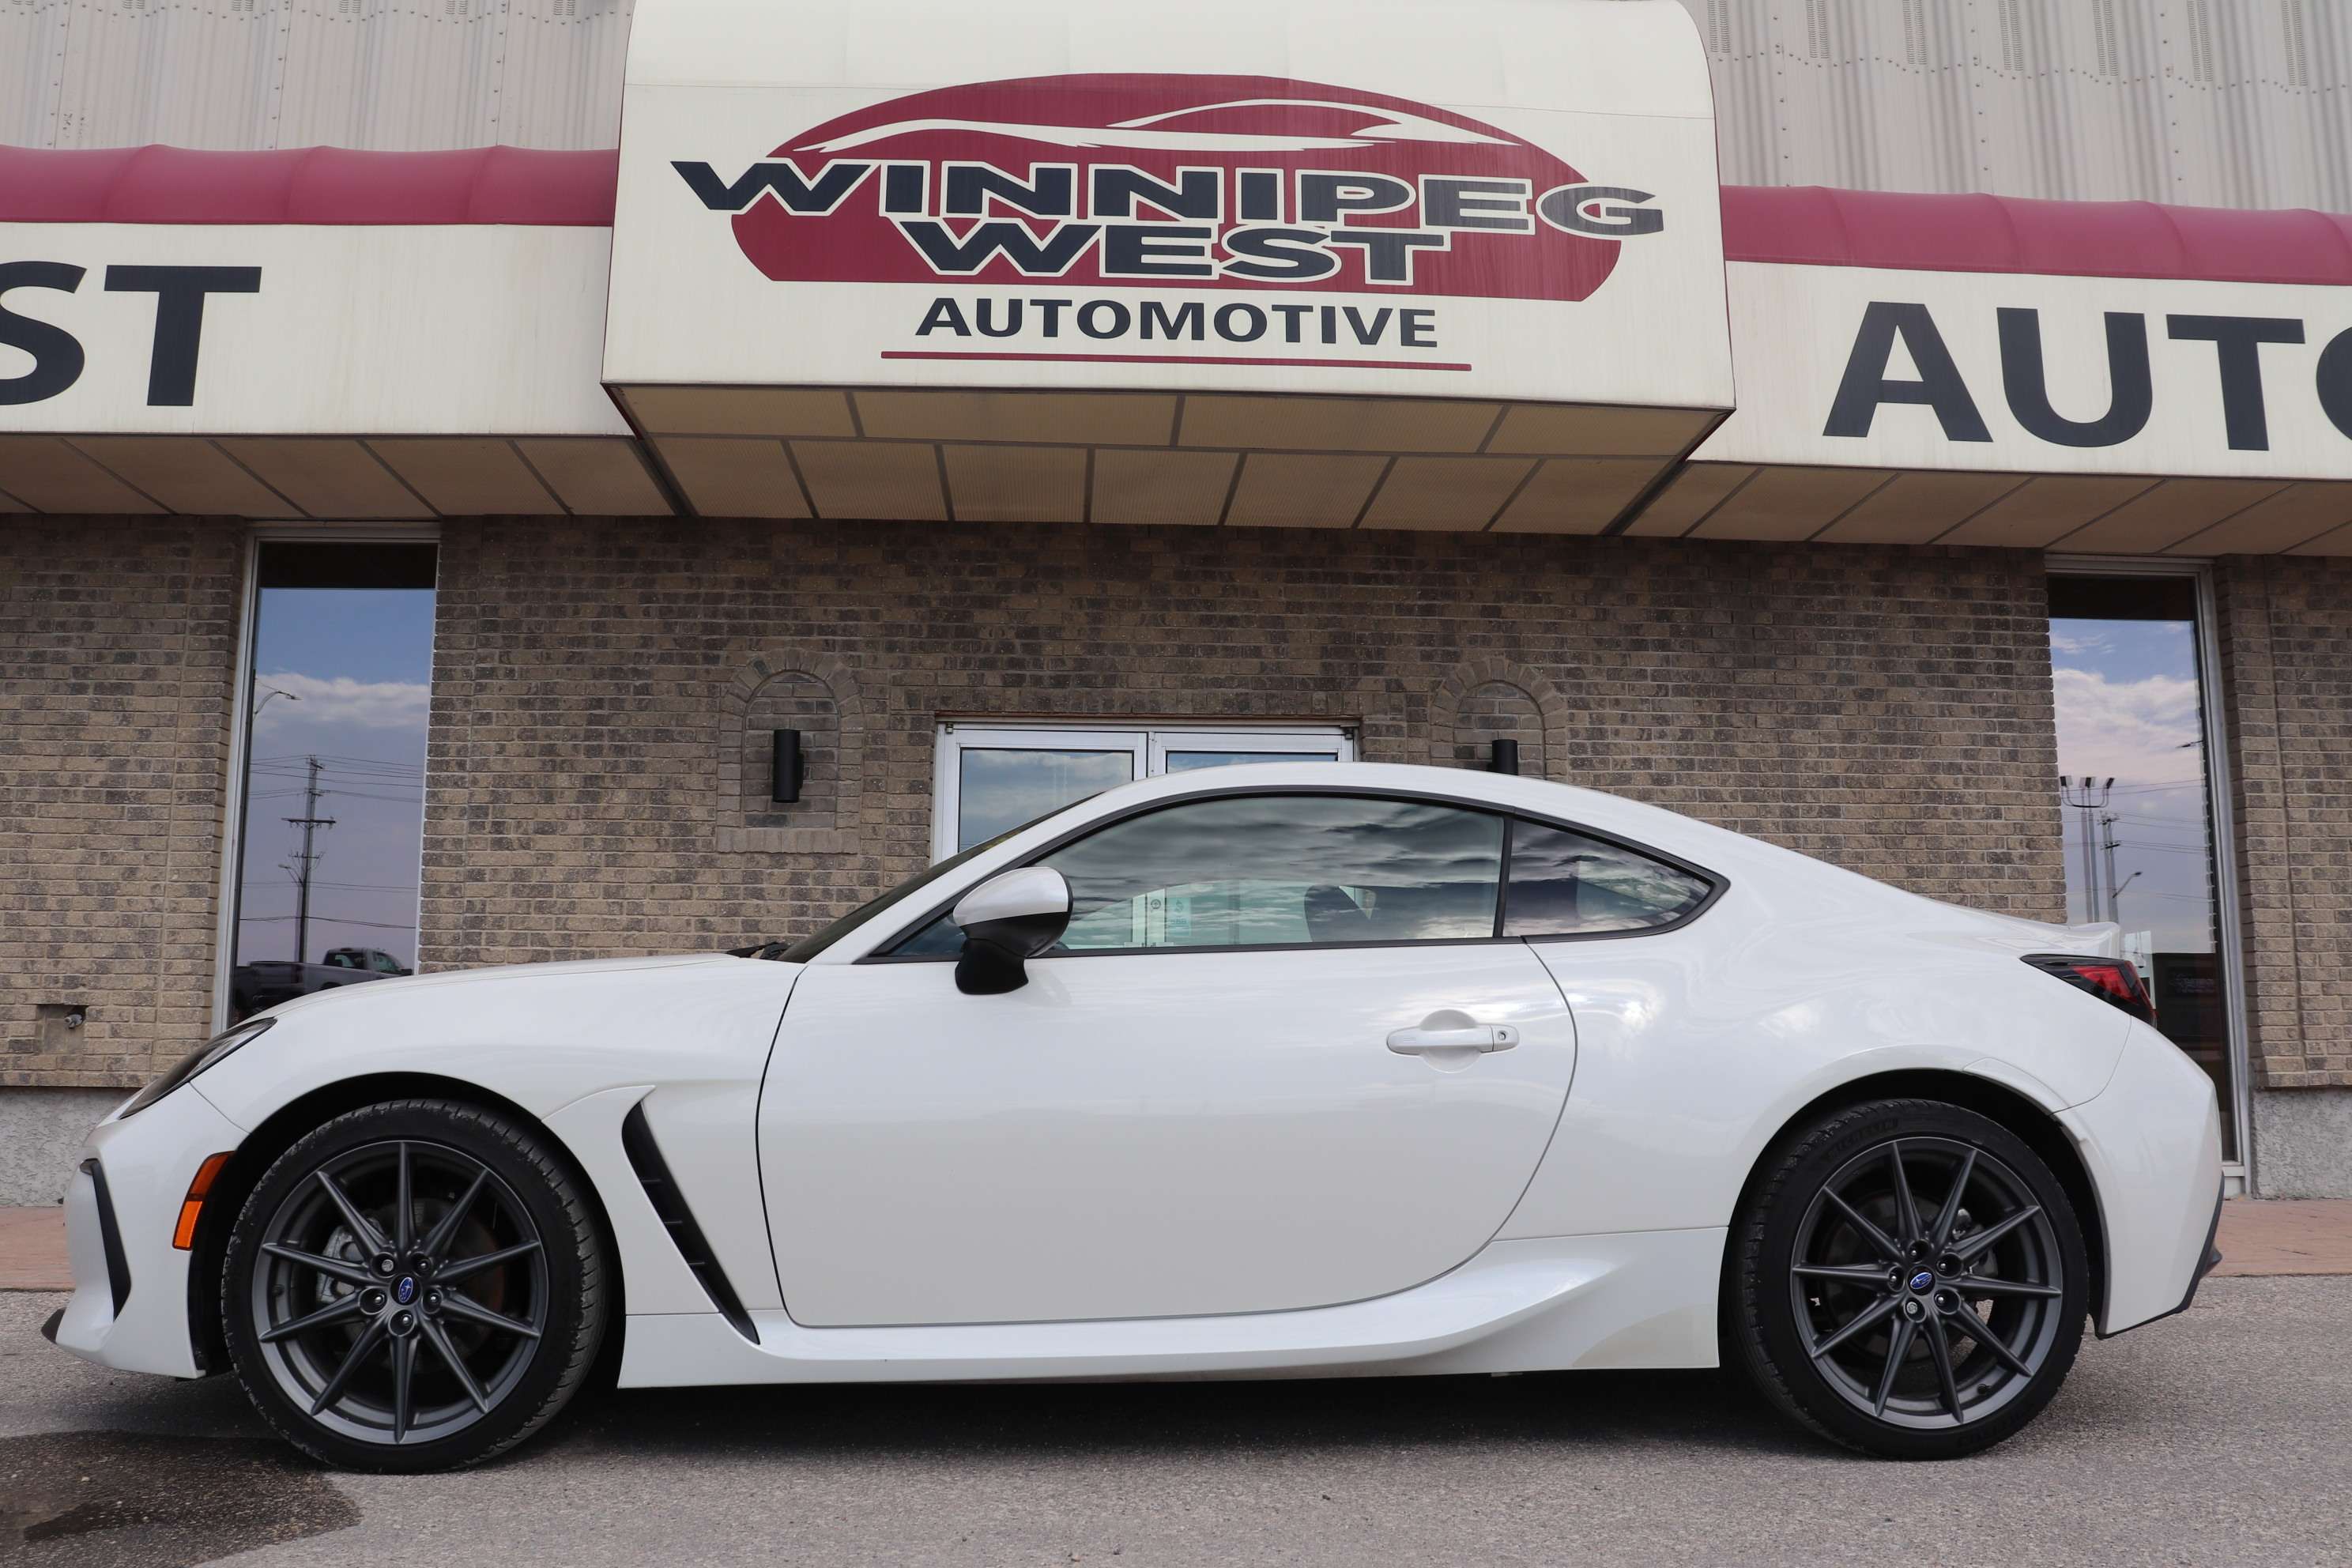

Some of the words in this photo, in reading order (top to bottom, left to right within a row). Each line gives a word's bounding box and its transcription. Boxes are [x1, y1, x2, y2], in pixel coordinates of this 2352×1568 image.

[670, 160, 1664, 236] WINNIPEG
[899, 220, 1445, 281] WEST
[0, 261, 262, 406] ST
[915, 296, 1438, 348] AUTOMOTIVE
[1822, 301, 2352, 451] AUT
